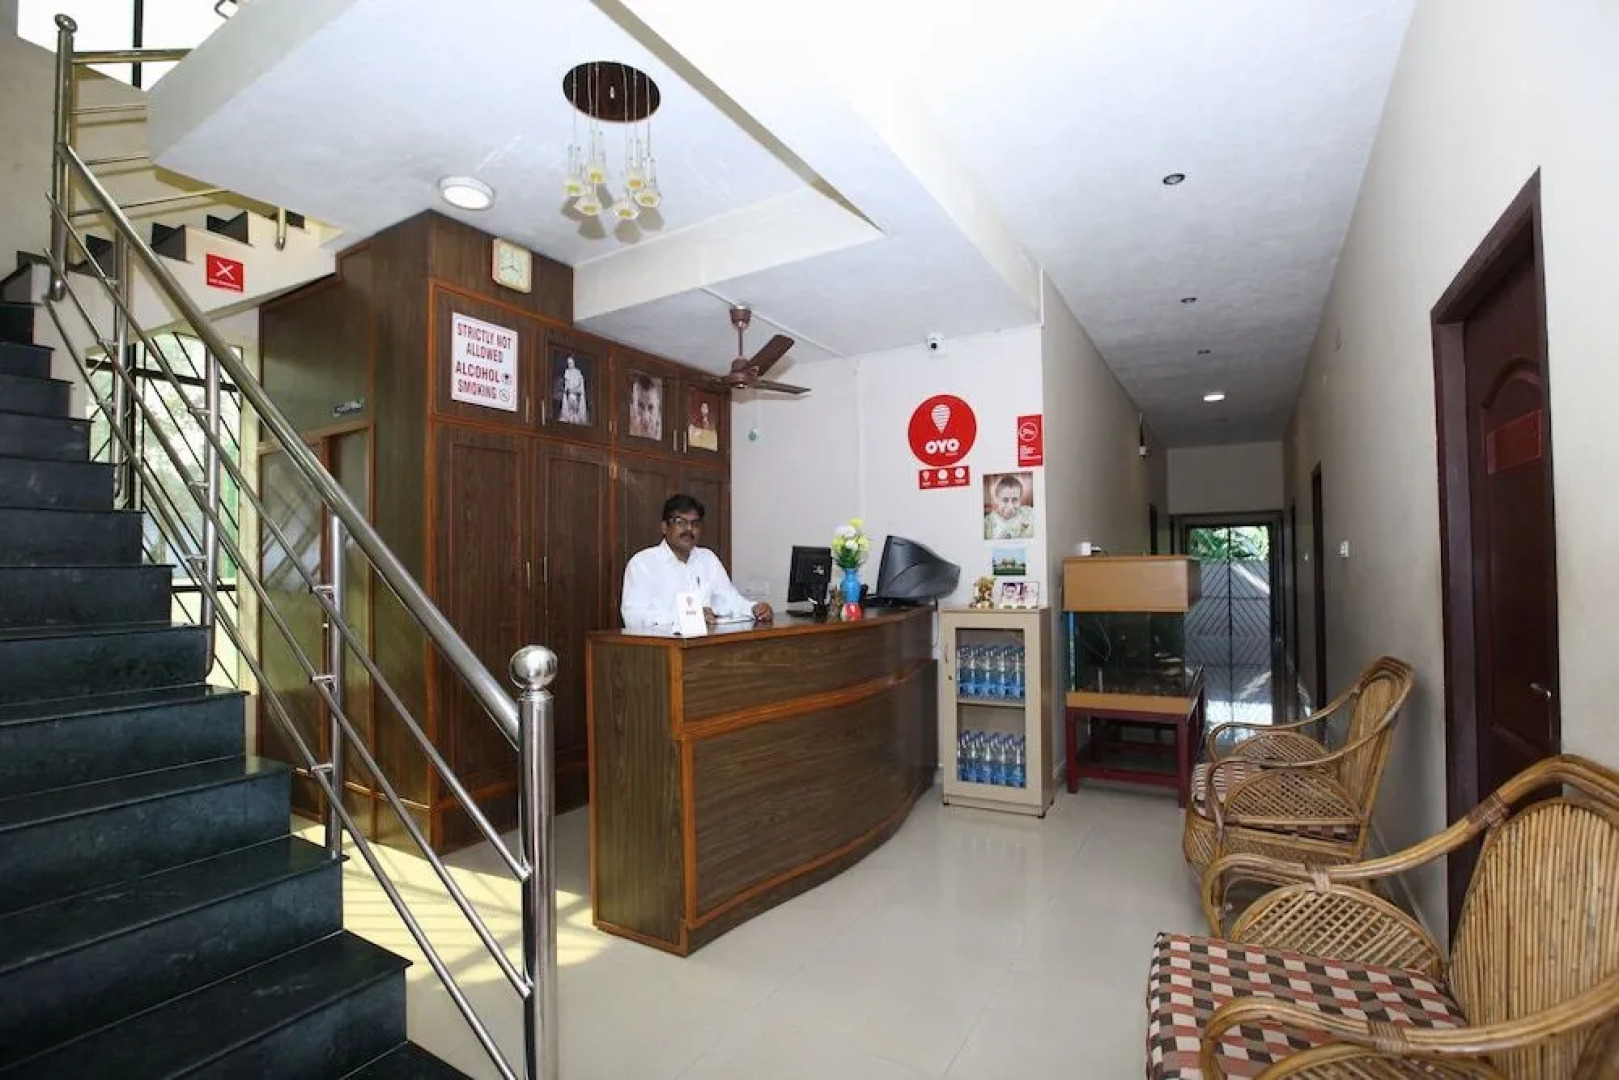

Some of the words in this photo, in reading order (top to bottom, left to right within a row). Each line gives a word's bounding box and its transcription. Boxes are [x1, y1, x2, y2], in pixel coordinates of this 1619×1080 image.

[457, 323, 495, 345] STRICTLY
[497, 333, 512, 350] NOT
[466, 342, 504, 363] ALLOWED
[455, 360, 500, 383] ALCOHOL
[457, 378, 497, 399] SMOKING
[925, 438, 960, 454] OYO
